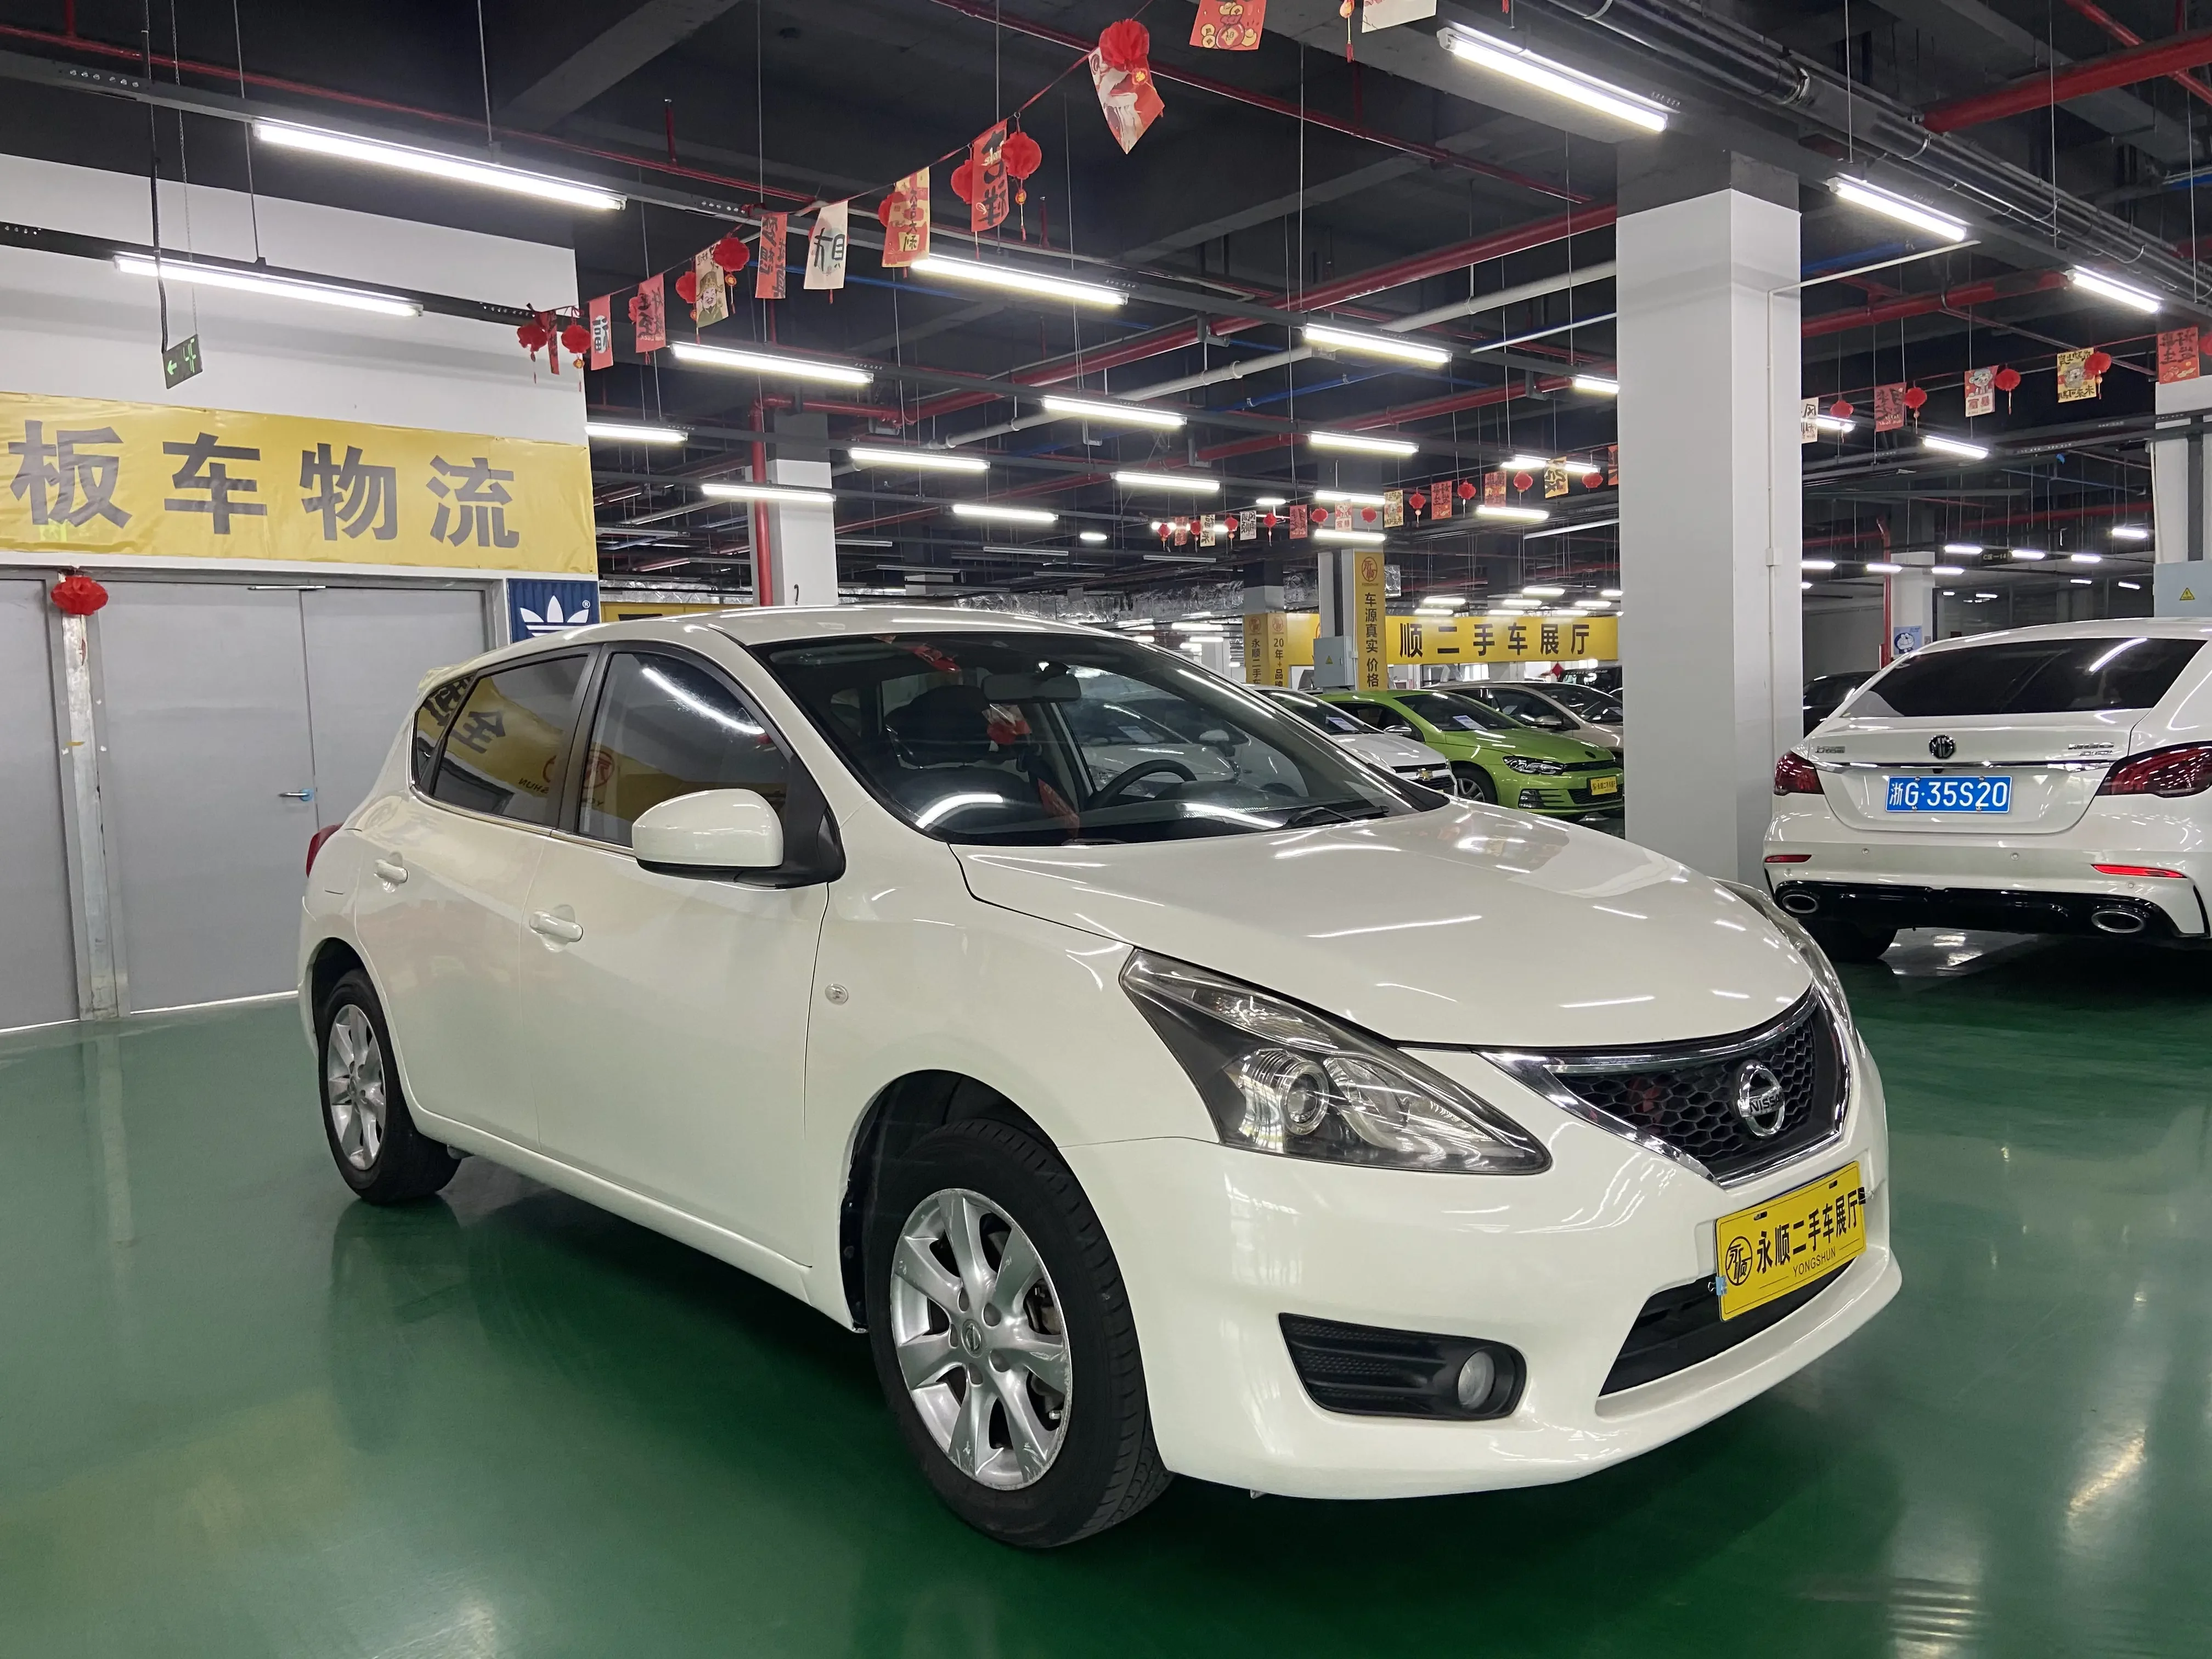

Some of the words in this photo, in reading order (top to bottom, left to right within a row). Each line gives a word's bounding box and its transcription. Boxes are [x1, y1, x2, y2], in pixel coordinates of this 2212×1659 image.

[8, 420, 520, 548] 板车物流
[1756, 1190, 1861, 1274] 永顺二手车展厅
[1792, 1246, 1836, 1278] YONGSHUN
